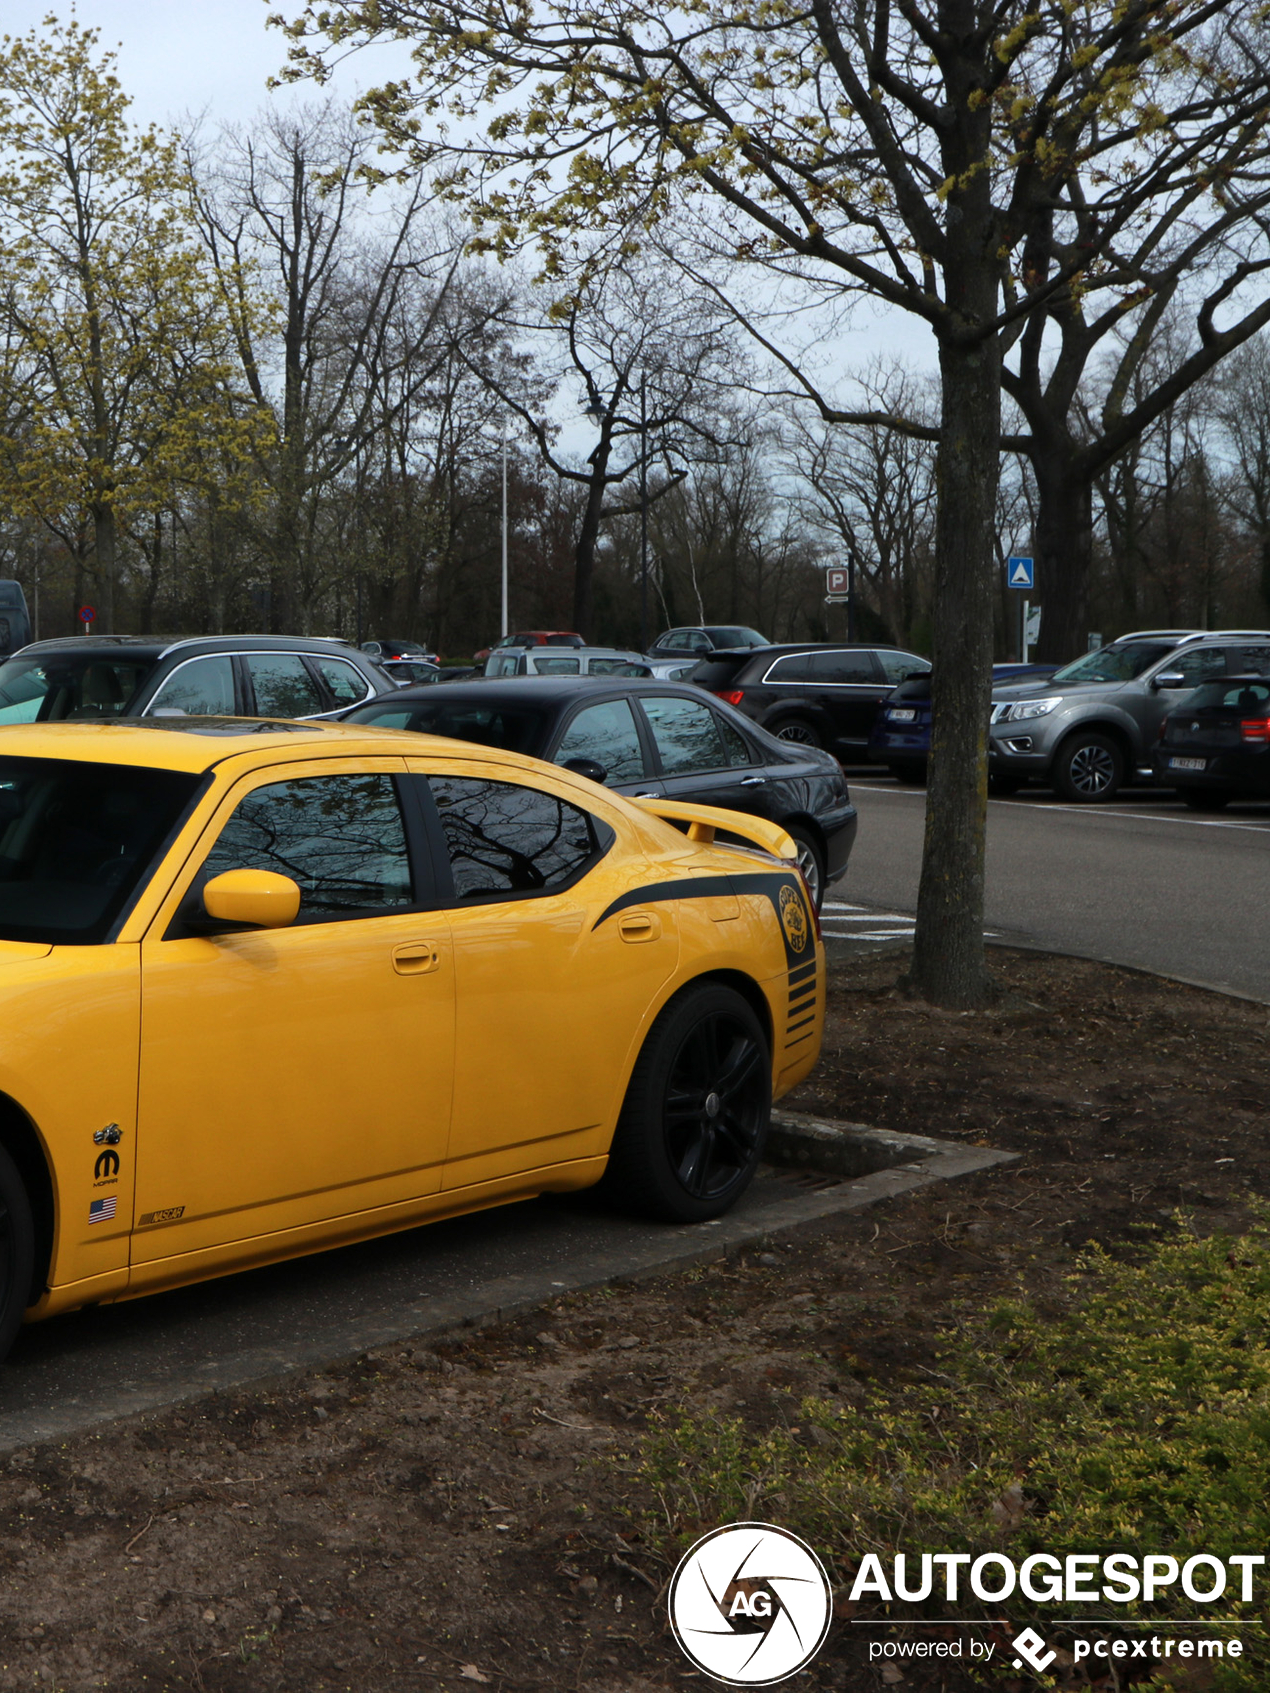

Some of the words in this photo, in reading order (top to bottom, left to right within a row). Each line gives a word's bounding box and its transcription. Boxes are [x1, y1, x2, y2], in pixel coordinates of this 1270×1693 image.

[832, 573, 844, 588] P
[780, 886, 803, 913] SUPER
[791, 931, 805, 951] BEE
[93, 1178, 118, 1188] MOPAR
[151, 1206, 185, 1224] NASCAR
